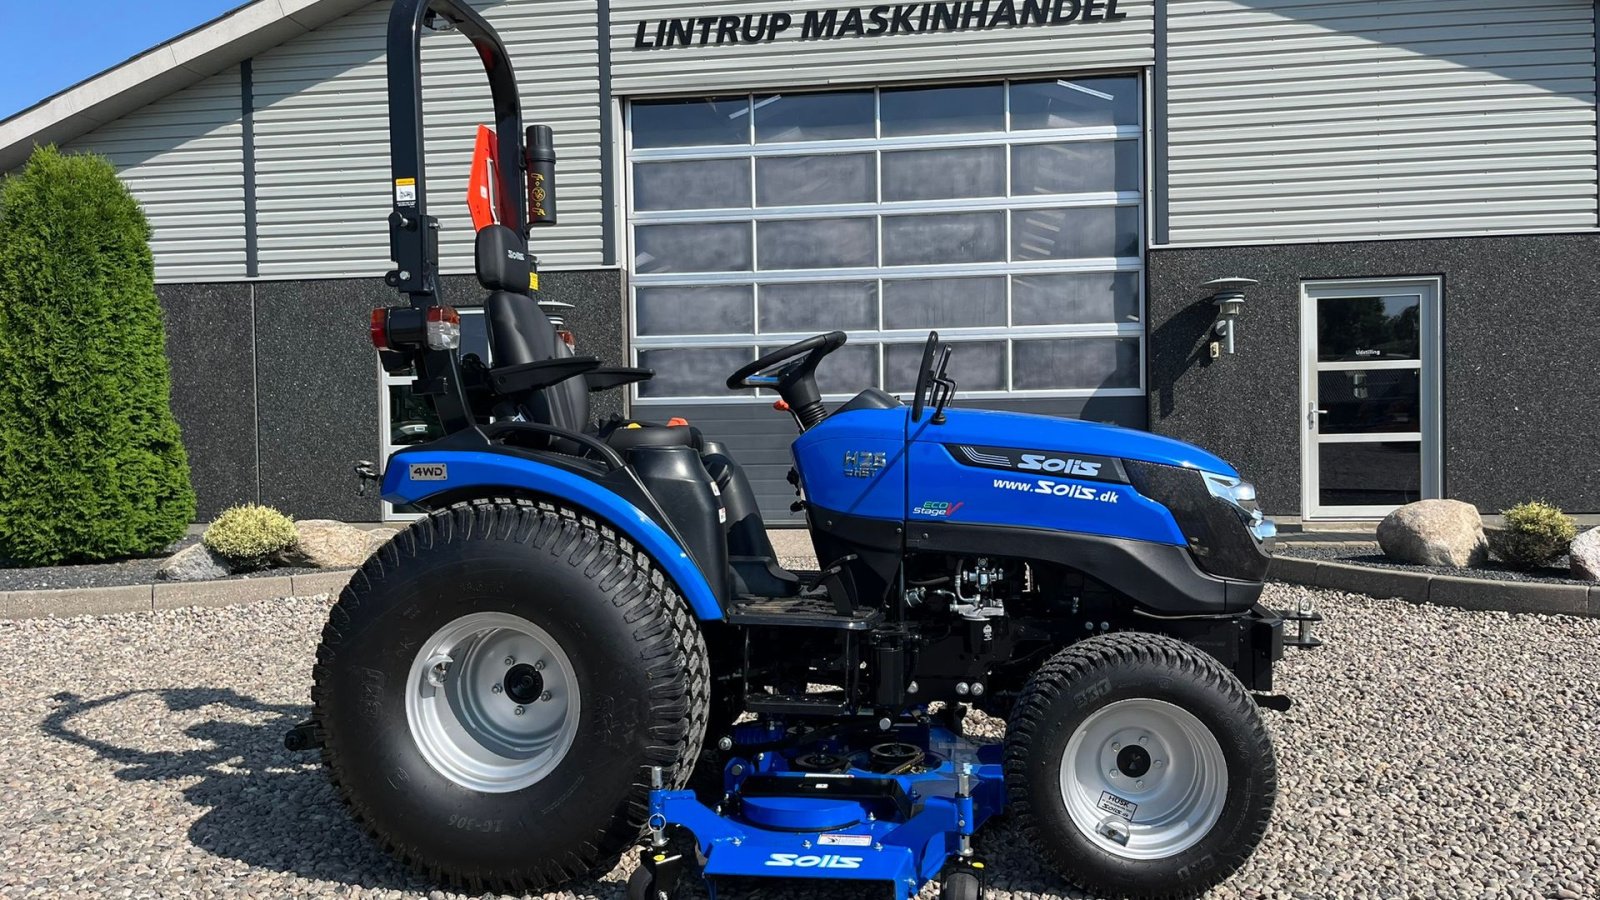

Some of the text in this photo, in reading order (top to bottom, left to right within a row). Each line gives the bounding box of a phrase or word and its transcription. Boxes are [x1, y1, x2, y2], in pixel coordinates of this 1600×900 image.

[634, 0, 1129, 49] LINTRUP MASKINHANDEL
[413, 467, 443, 477] 4WD
[924, 501, 948, 509] ECO
[1108, 794, 1130, 808] HUSK
